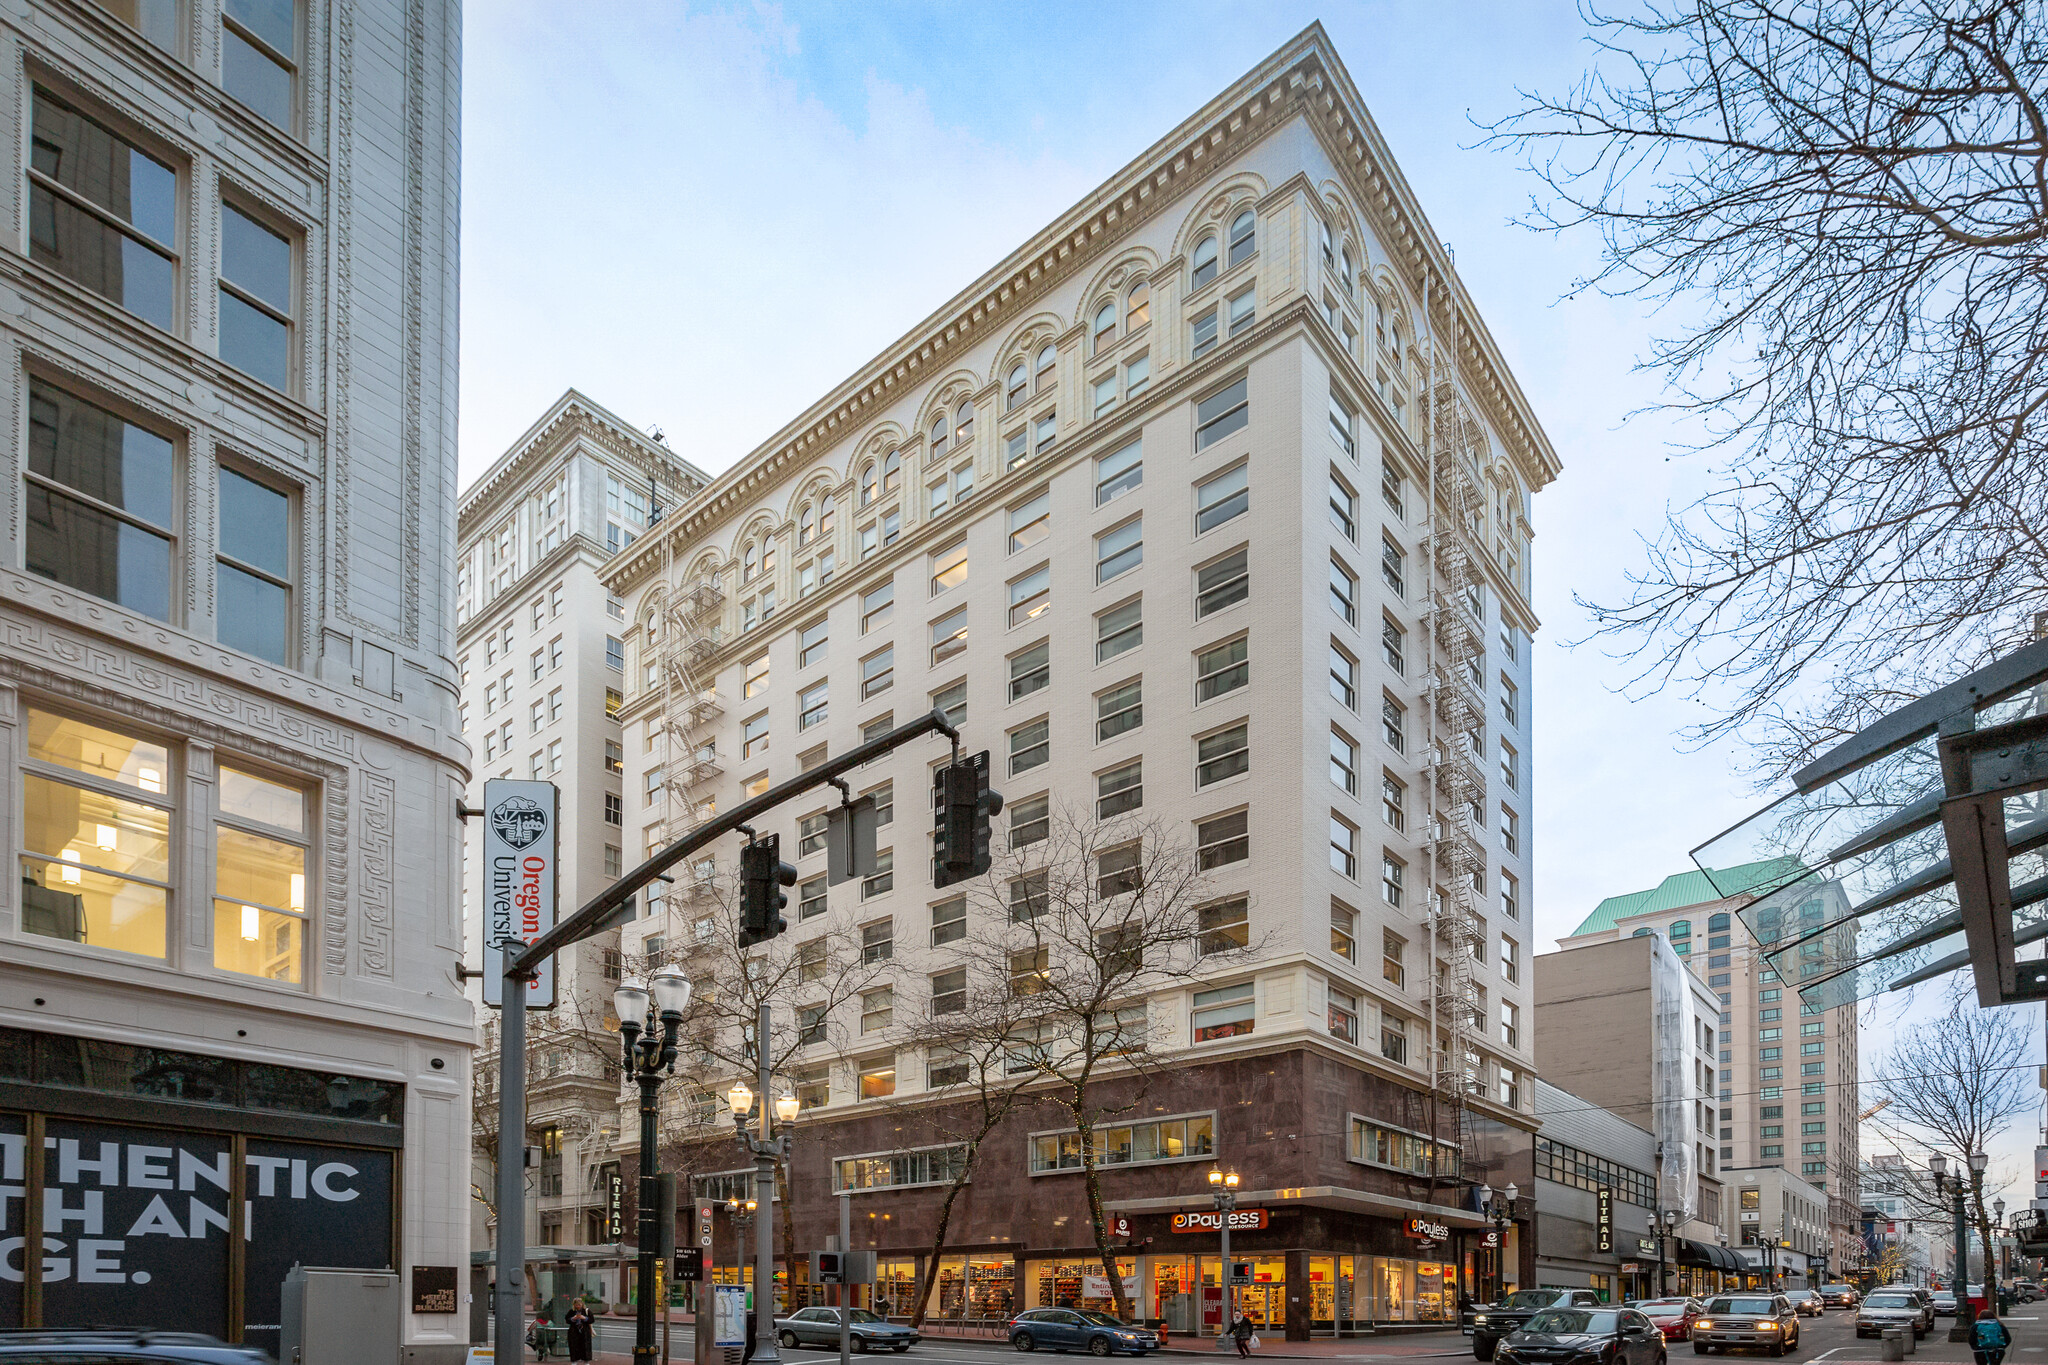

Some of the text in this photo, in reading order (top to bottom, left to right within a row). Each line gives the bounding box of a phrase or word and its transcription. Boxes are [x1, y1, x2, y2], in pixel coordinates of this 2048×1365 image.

[515, 856, 545, 933] Oregon
[1188, 1212, 1260, 1230] Payess
[1600, 1191, 1609, 1250] RITE AID
[2015, 1210, 2030, 1221] POP
[2018, 1218, 2038, 1230] SHOP
[1419, 1219, 1449, 1238] Payless
